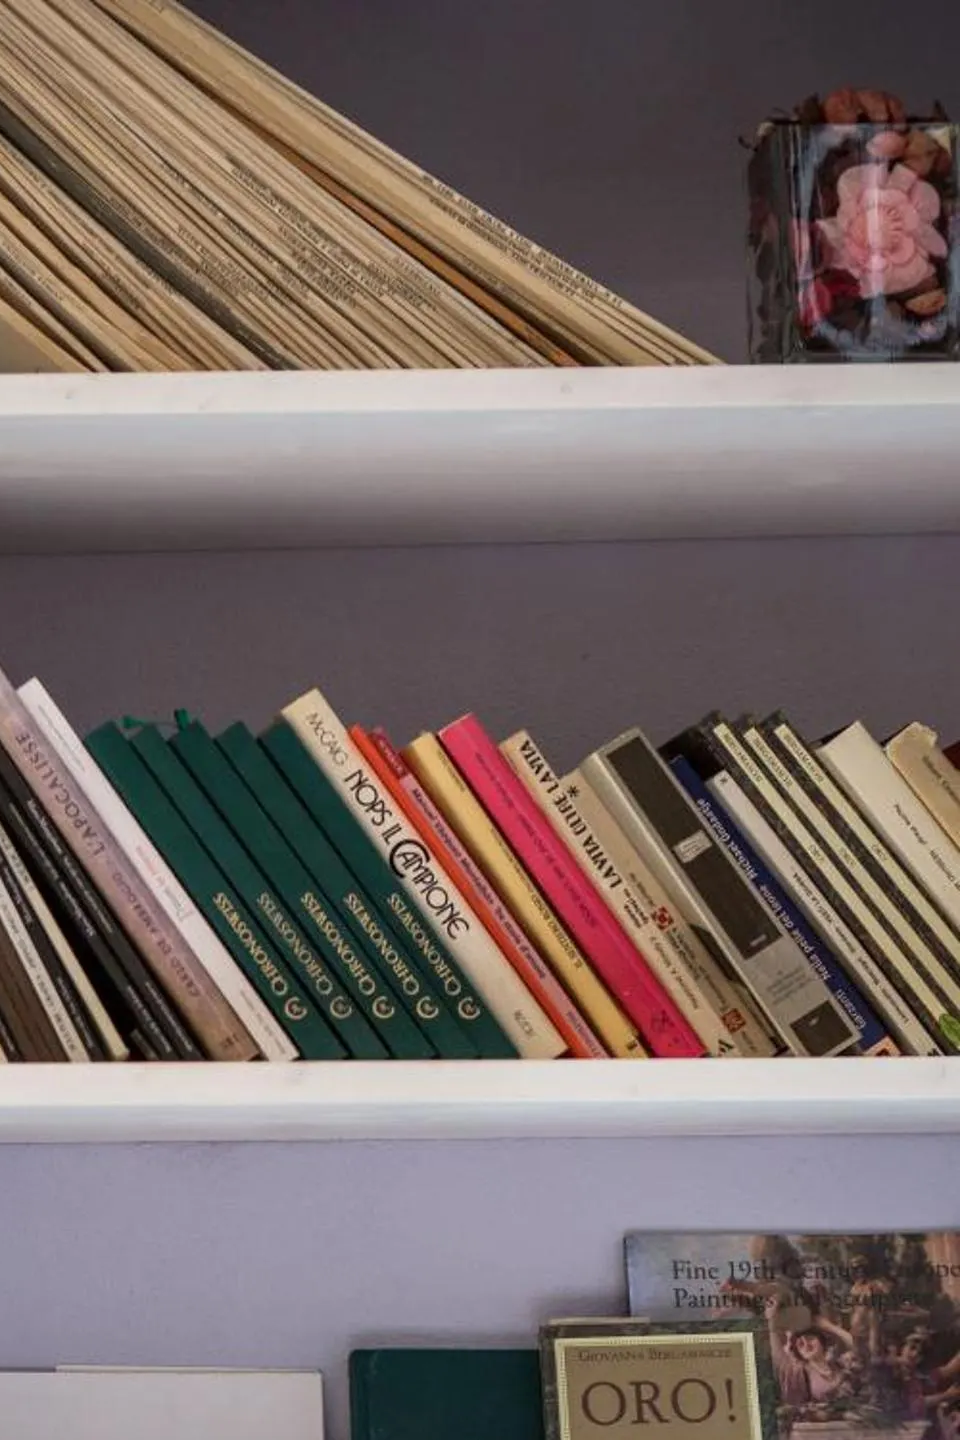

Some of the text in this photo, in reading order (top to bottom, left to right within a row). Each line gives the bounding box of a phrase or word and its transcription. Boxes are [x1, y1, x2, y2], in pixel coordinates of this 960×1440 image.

[344, 768, 392, 826] NOPS
[380, 822, 405, 845] IL
[516, 739, 623, 891] LA VITA OLTRE LA VITA
[776, 910, 795, 930] del
[671, 1260, 720, 1280] Fine
[727, 1258, 776, 1280] 19th
[672, 1287, 776, 1312] Paintings
[581, 1377, 737, 1426] ORO!
